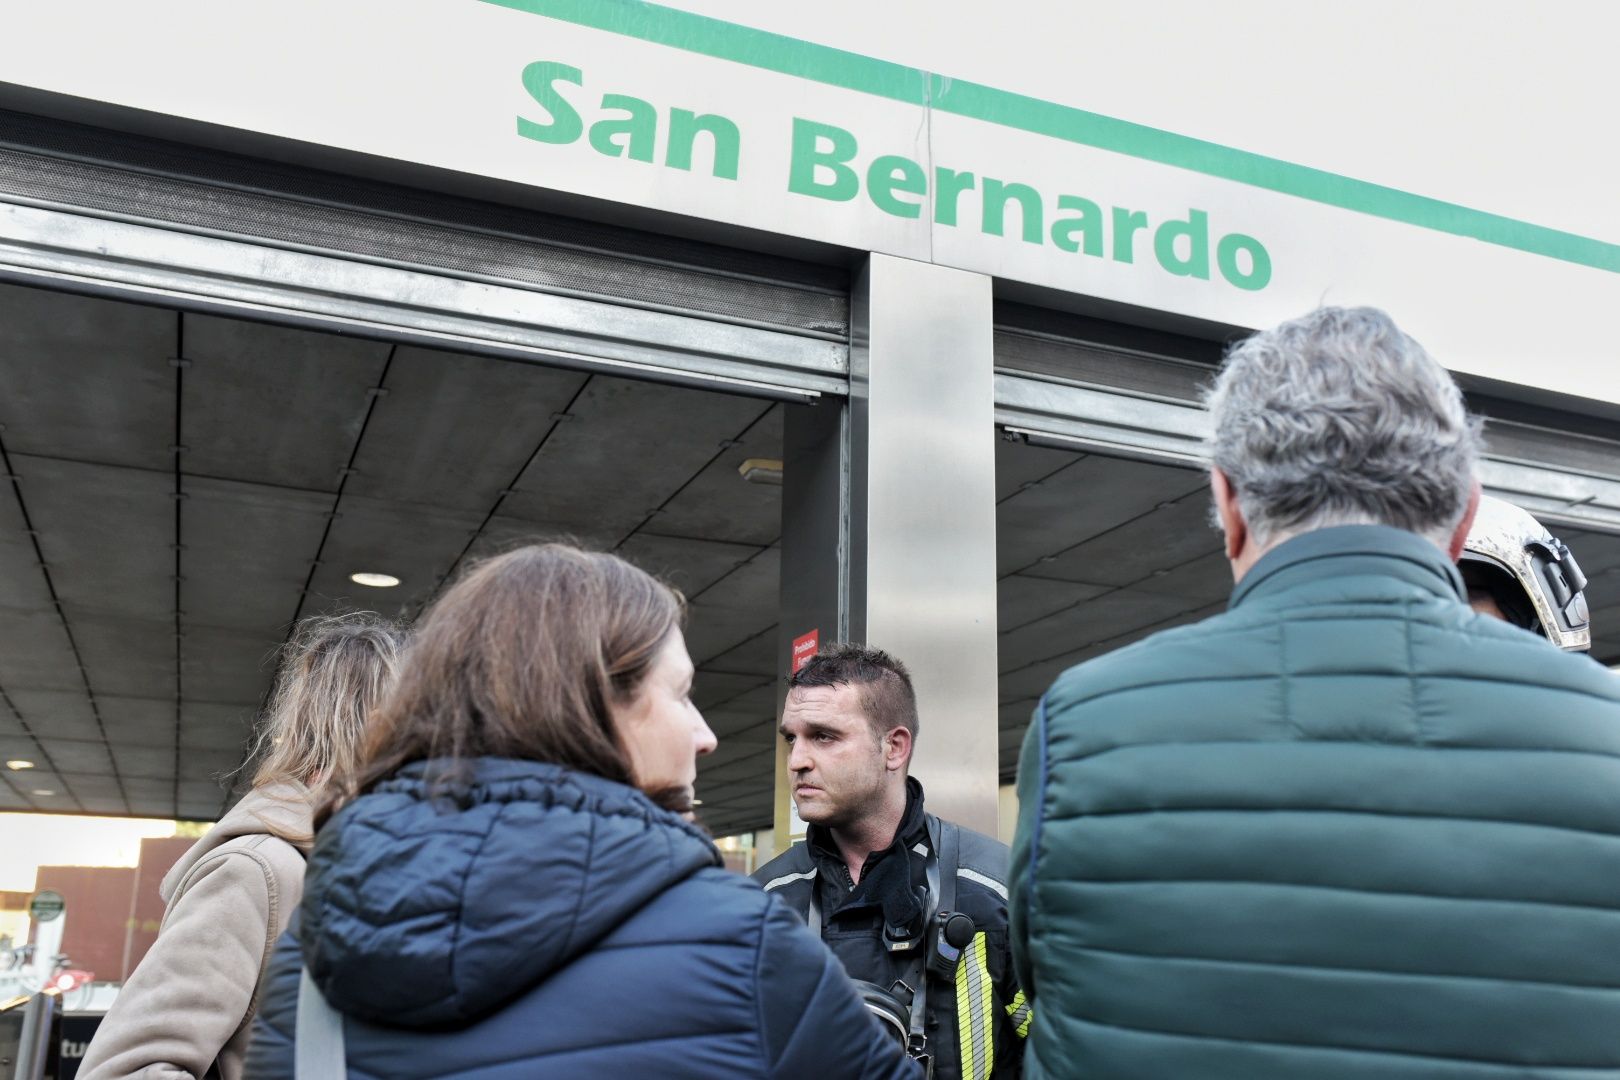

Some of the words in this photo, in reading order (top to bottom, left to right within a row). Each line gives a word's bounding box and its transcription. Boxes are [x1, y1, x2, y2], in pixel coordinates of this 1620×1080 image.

[517, 60, 741, 180] San
[789, 117, 1273, 291] Bernardo
[60, 1038, 90, 1058] tu
